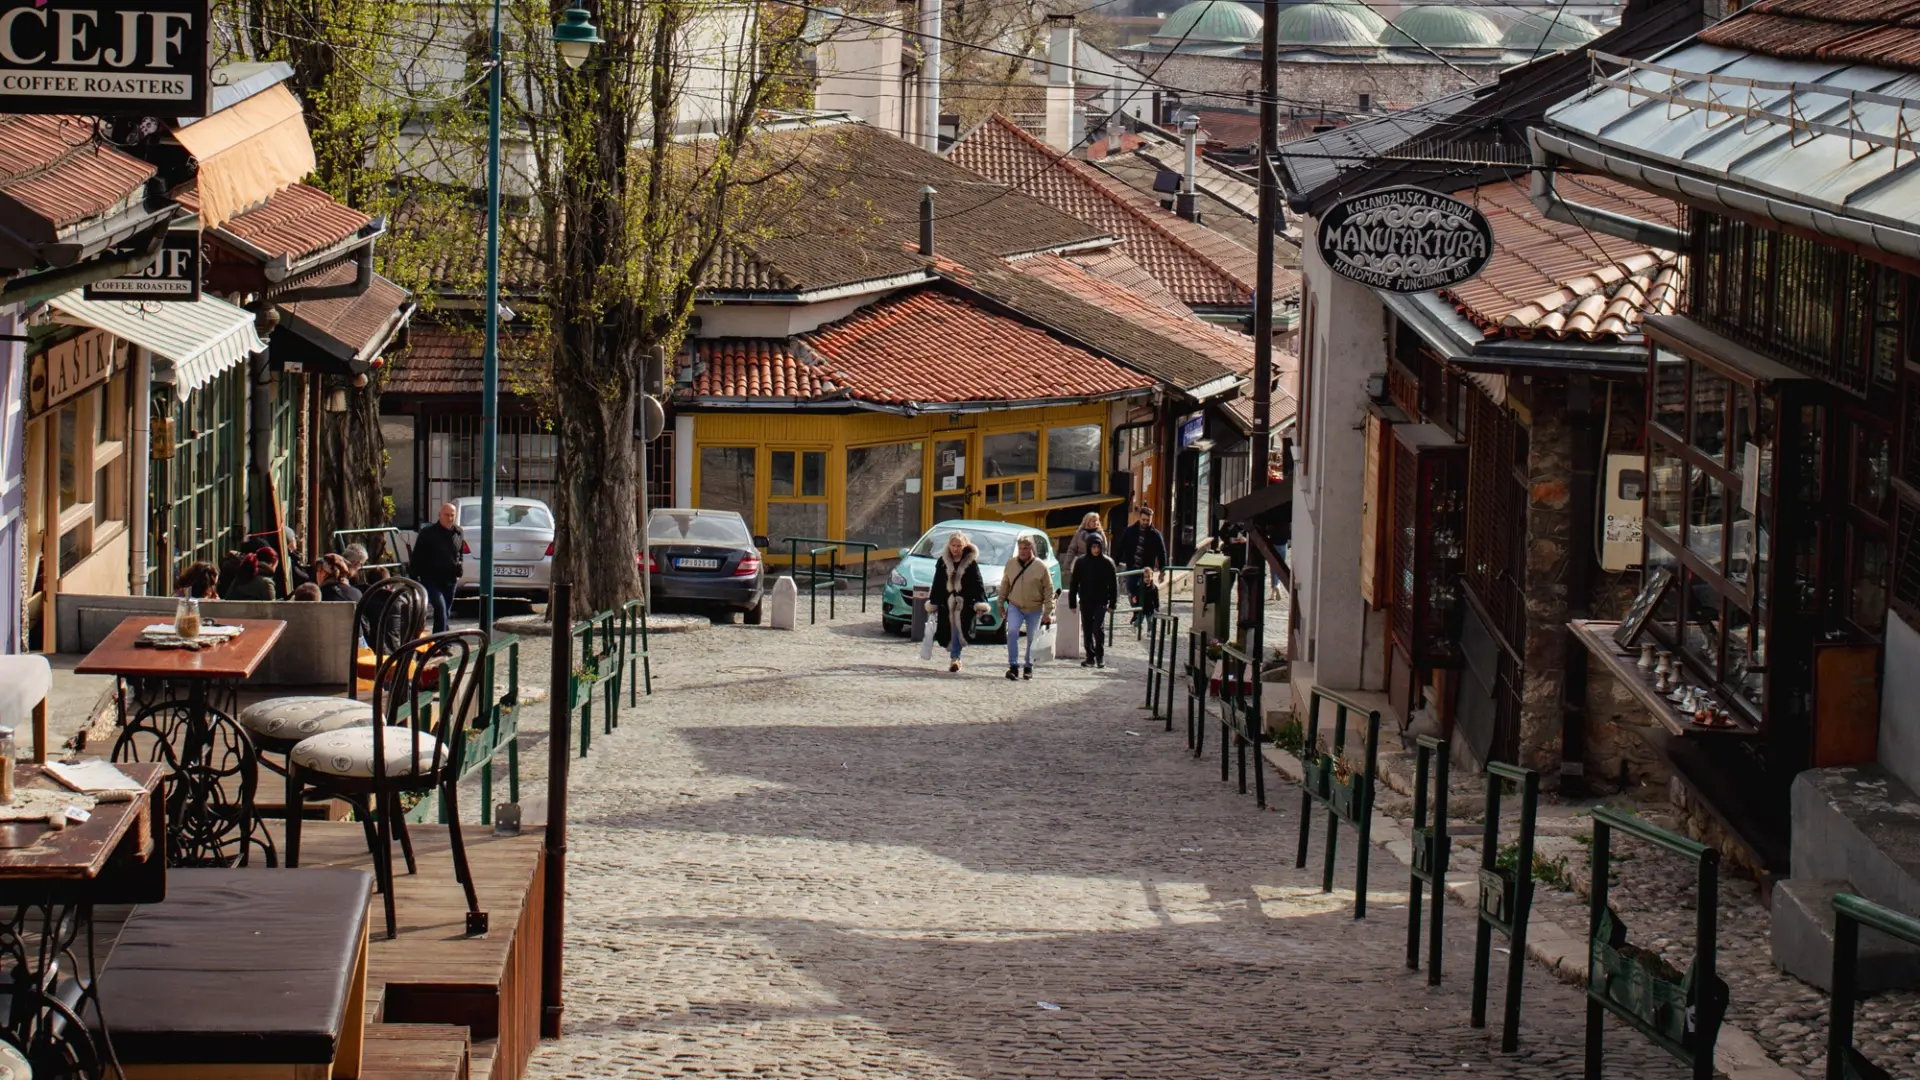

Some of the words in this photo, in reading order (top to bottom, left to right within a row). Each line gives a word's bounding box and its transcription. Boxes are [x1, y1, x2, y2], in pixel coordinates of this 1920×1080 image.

[3, 75, 79, 92] COFFEE
[84, 78, 185, 95] ROASTERS
[1346, 191, 1427, 215] KAZANDŽIJSKA
[1431, 196, 1474, 222] RADNJA
[1324, 225, 1486, 259] MANUFAKTURA
[95, 281, 134, 290] COFFEE
[136, 282, 188, 291] ROASTERS
[1332, 258, 1393, 288] HANDMADE
[1396, 271, 1452, 291] FUNCTIONAL
[1454, 262, 1470, 280] ART
